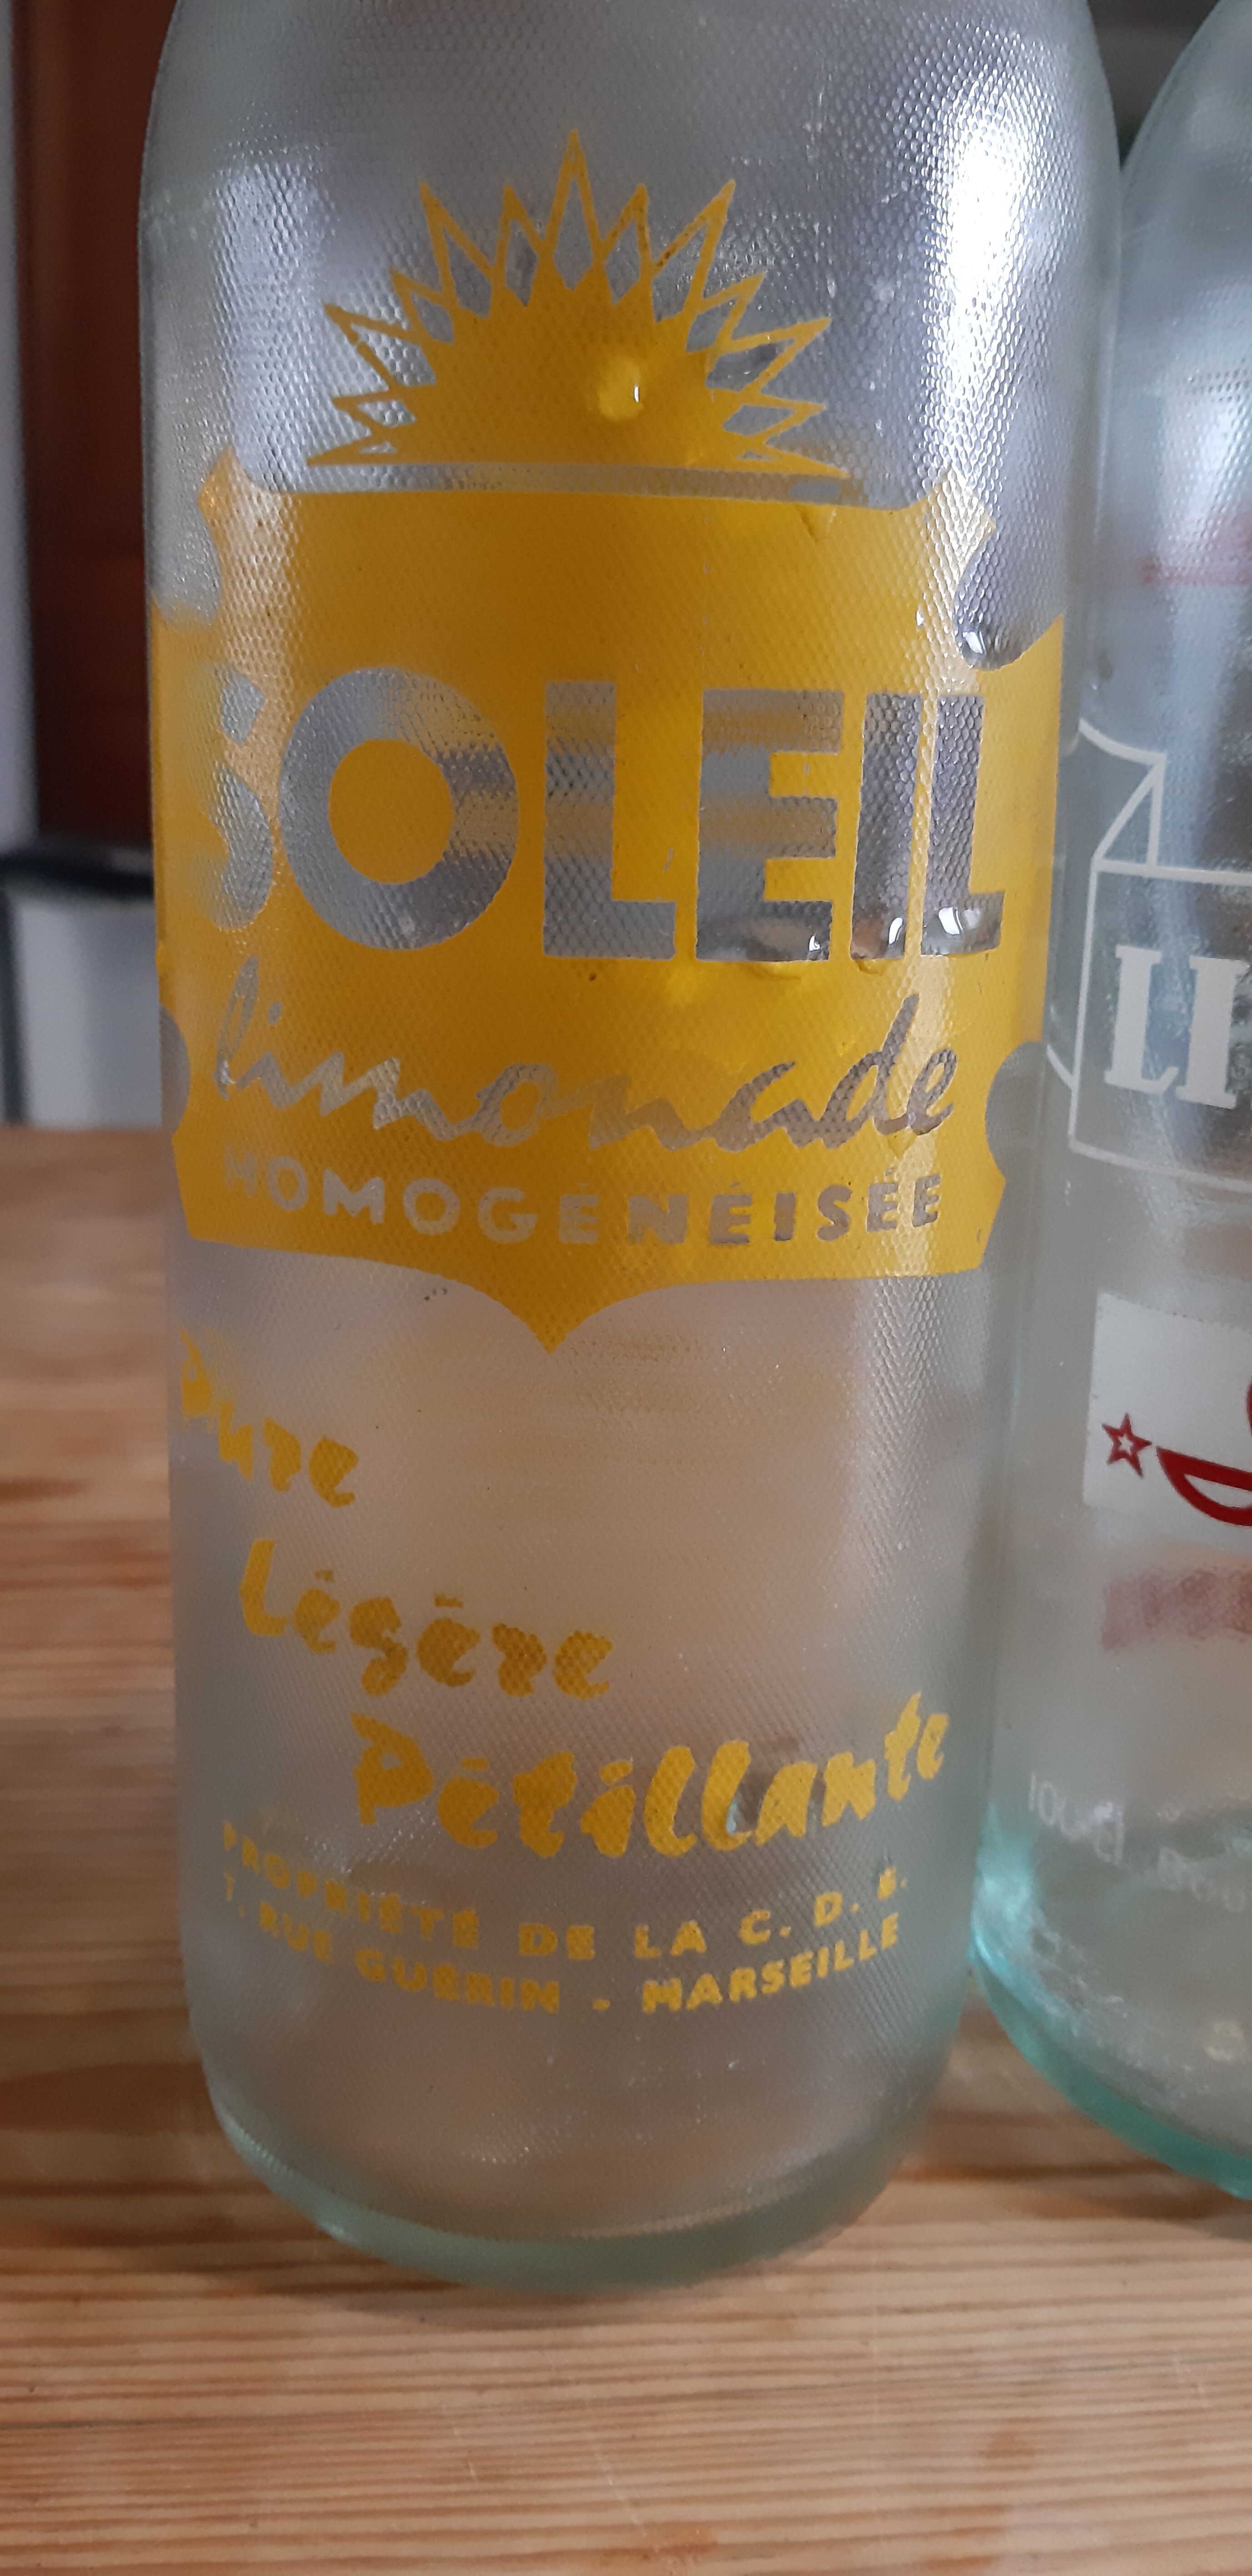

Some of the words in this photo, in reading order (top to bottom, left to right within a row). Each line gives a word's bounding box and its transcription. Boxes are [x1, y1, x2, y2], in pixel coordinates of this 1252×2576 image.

[184, 659, 1005, 961] SOLEIL
[213, 955, 957, 1153] limonade
[180, 1327, 358, 1508] Pure
[240, 1539, 614, 1701] Légère
[350, 1692, 949, 1857] Pétillante
[260, 1901, 334, 1964] RUE
[642, 1912, 899, 2014] MARSEILLE
[519, 1923, 595, 1960] DE
[635, 1920, 707, 1959] LA
